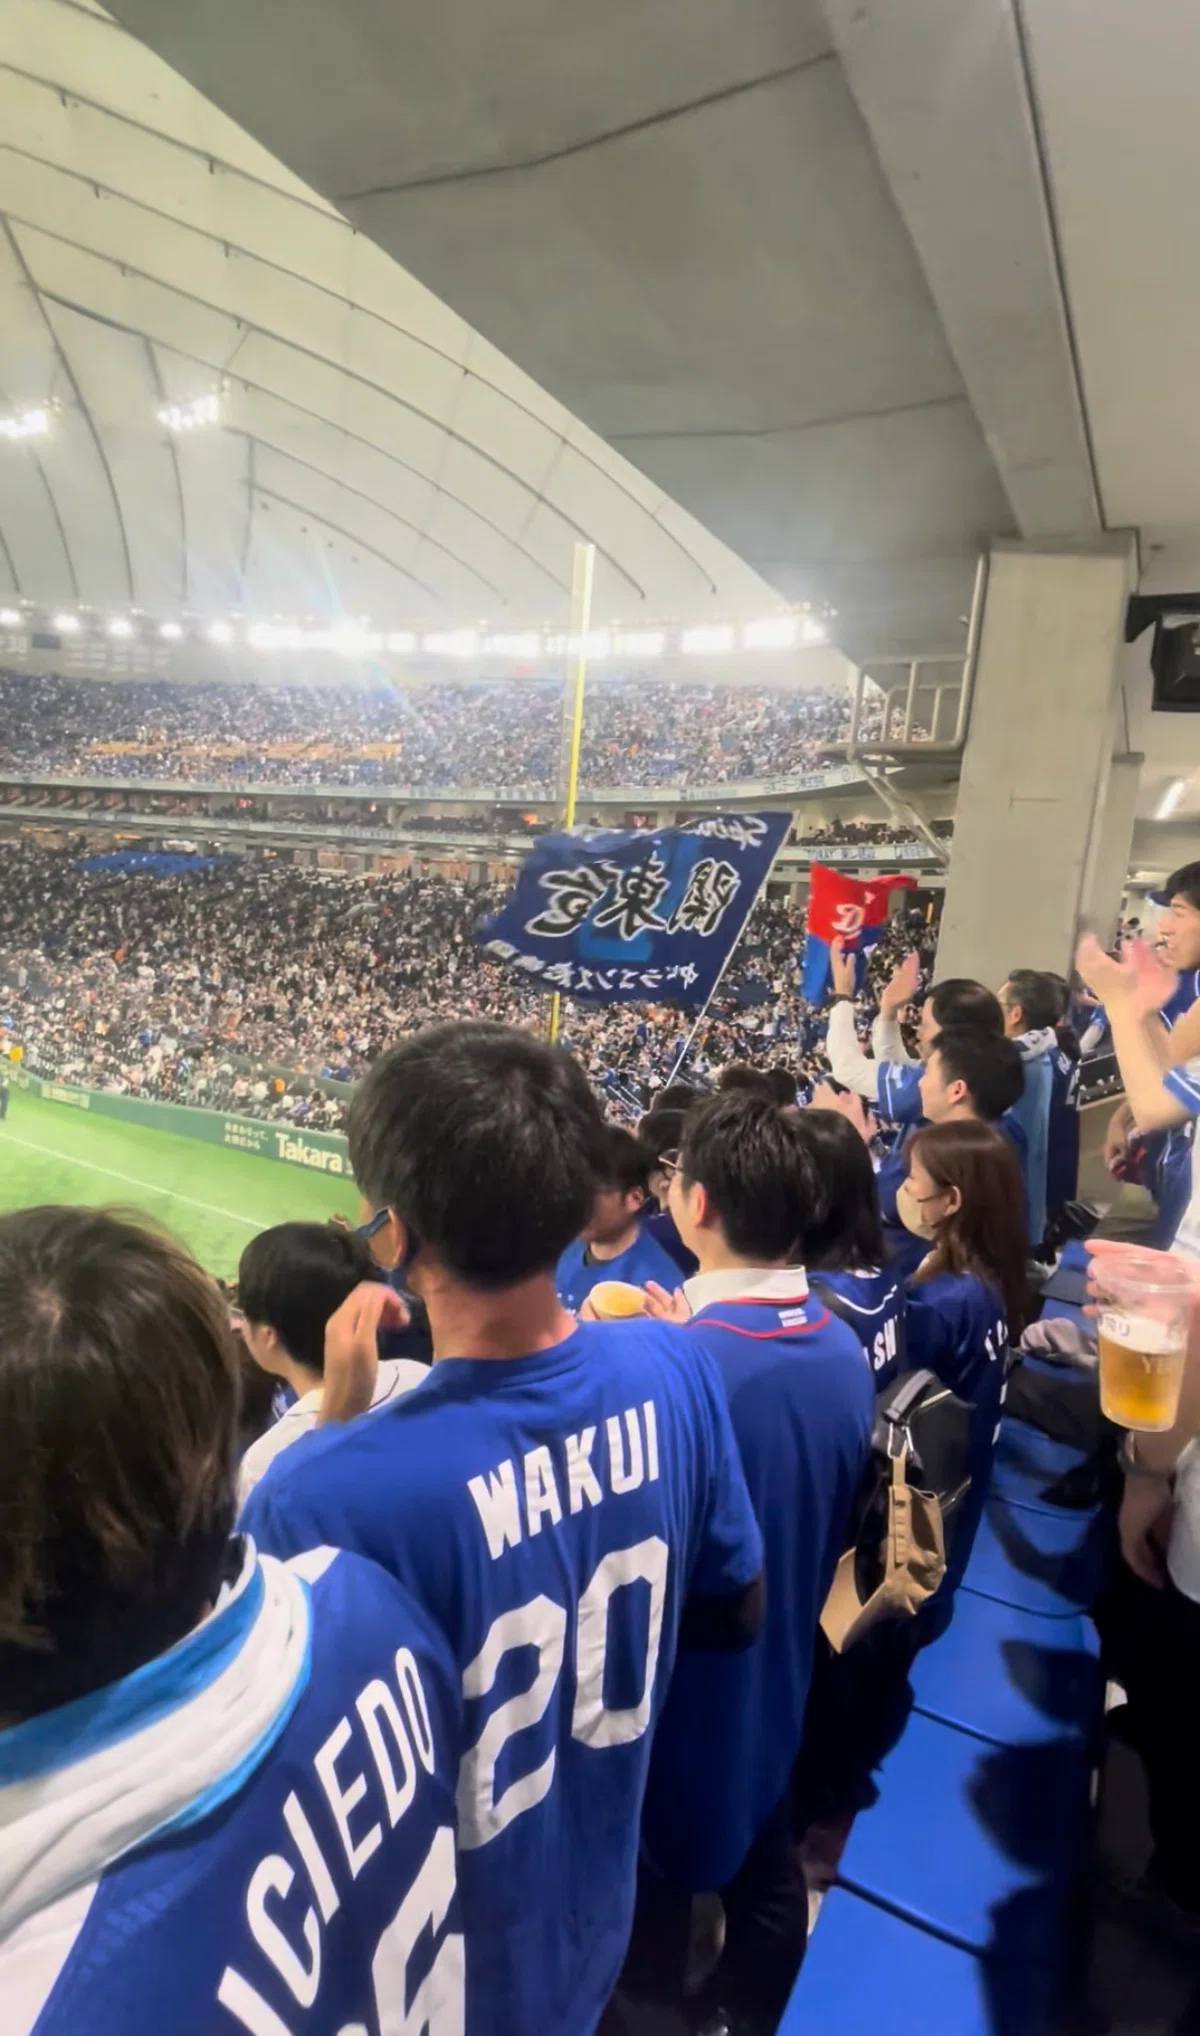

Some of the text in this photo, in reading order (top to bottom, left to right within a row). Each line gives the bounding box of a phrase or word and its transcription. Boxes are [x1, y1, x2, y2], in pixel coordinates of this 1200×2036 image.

[275, 1131, 342, 1173] Takara
[467, 1399, 660, 1560] WAKUI
[456, 1535, 669, 1850] 20
